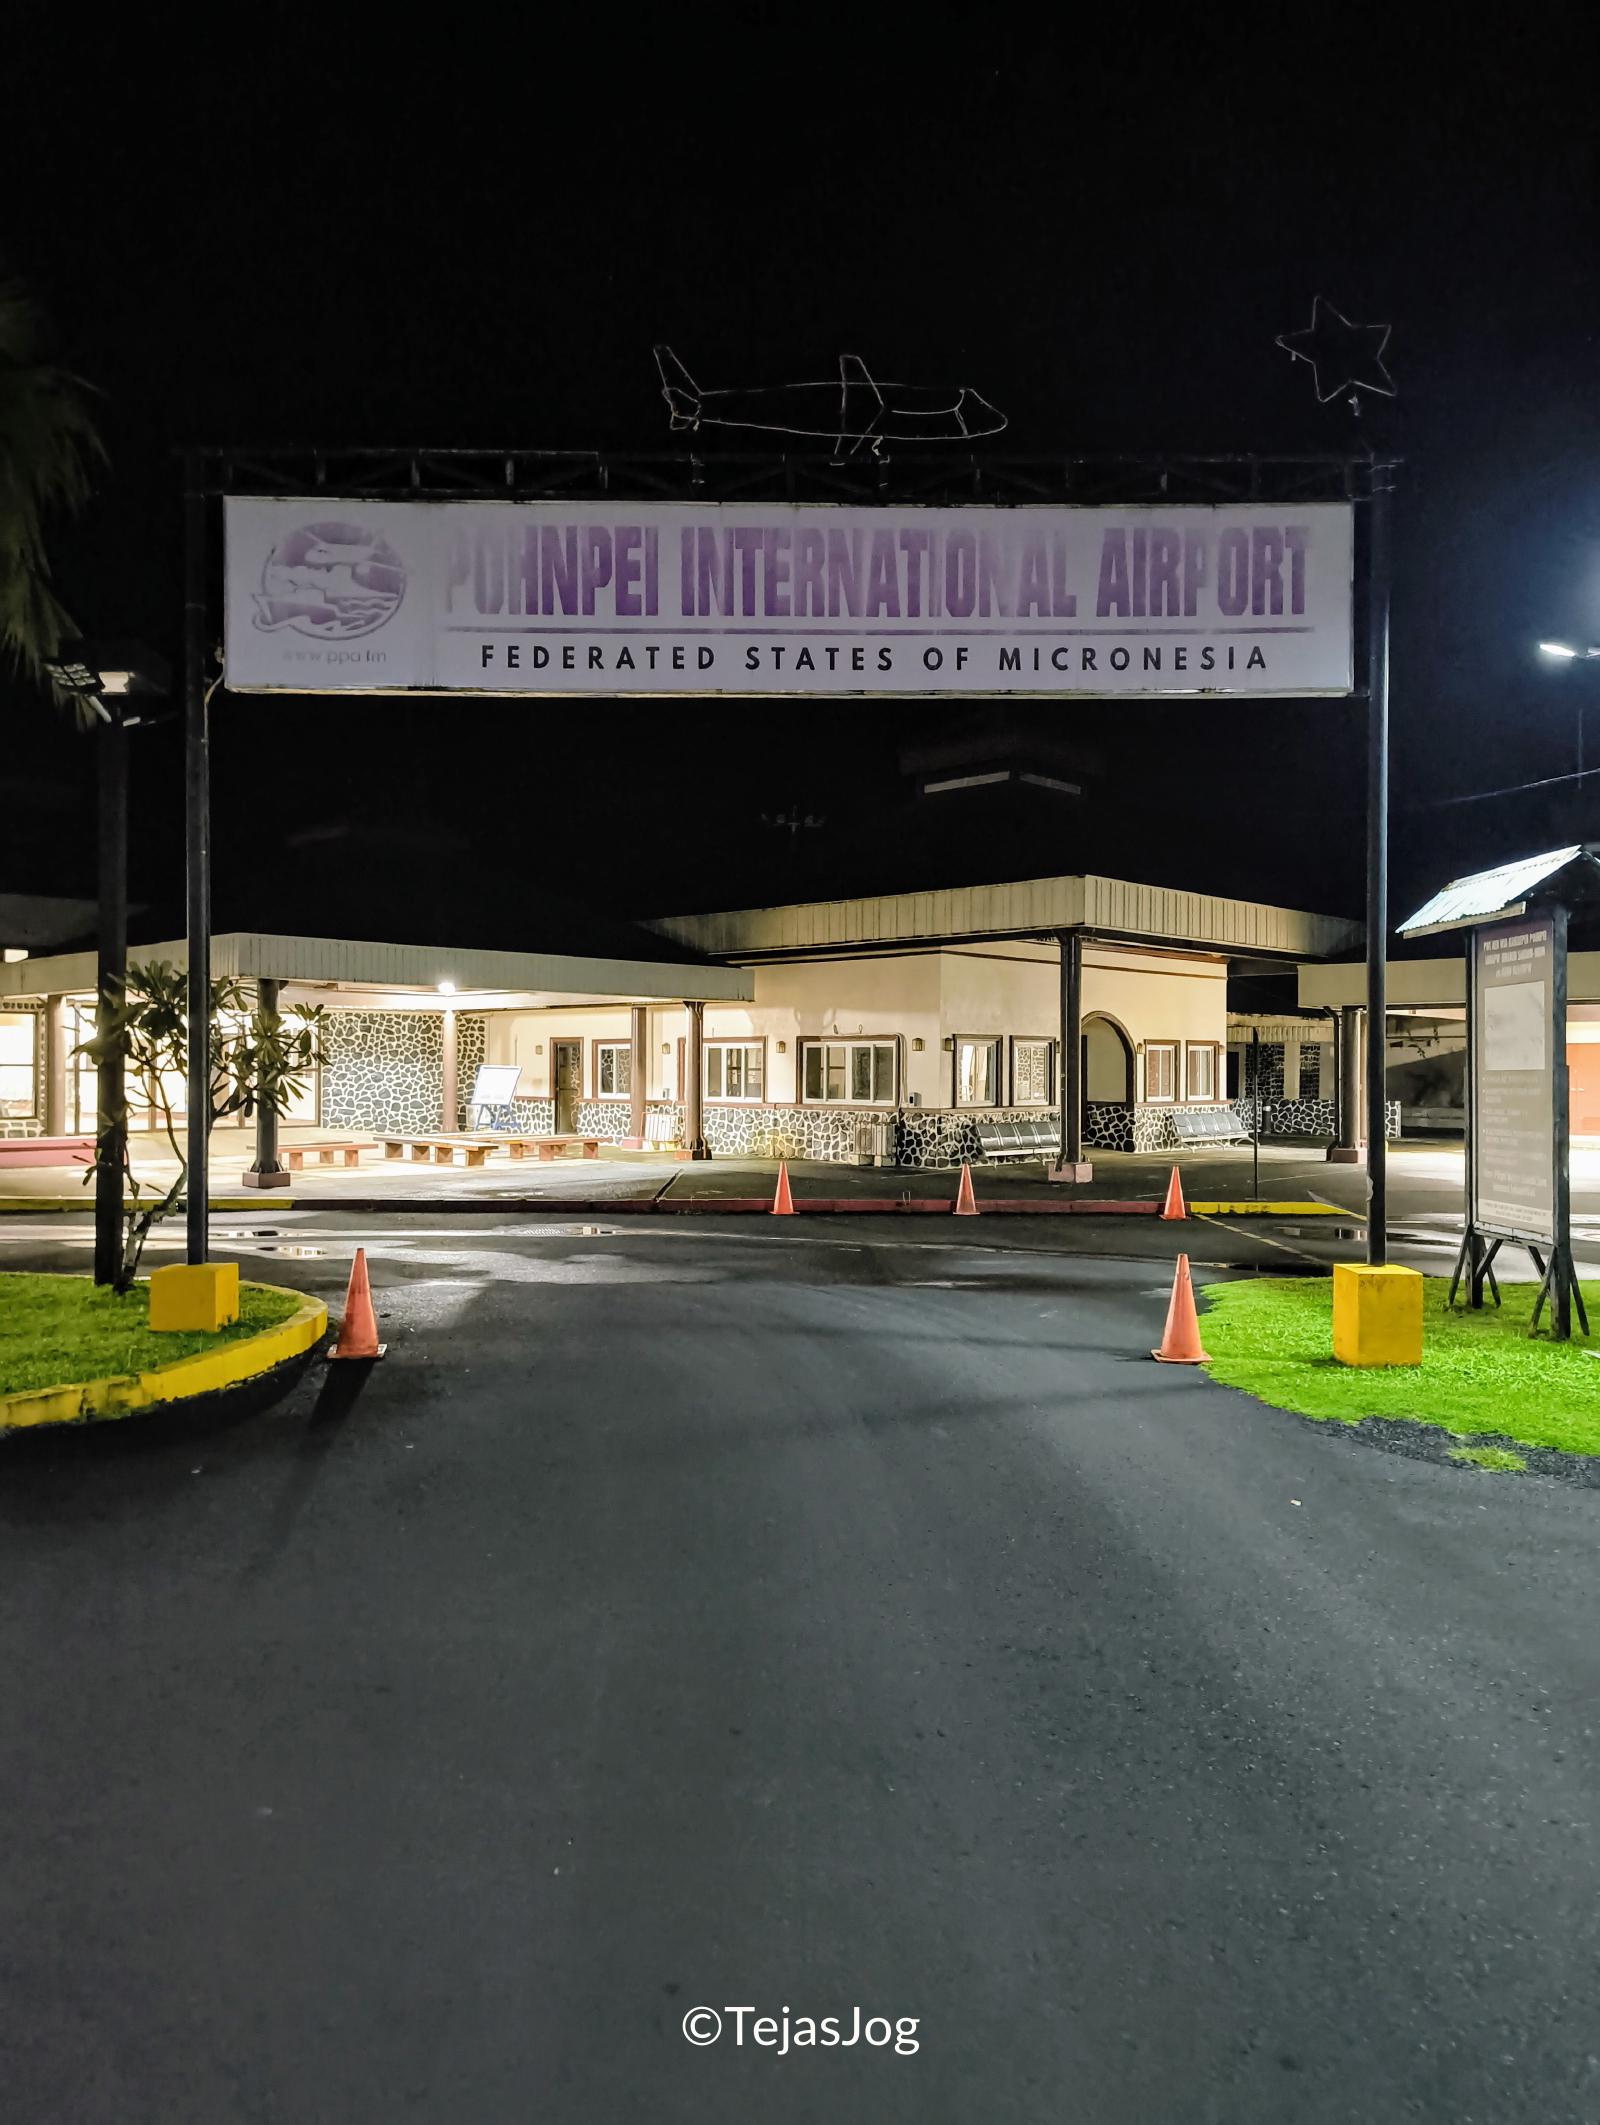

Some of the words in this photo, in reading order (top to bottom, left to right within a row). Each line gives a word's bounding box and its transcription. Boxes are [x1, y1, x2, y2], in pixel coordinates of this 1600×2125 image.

[681, 526, 1077, 618] INTERNATIONAL
[1096, 526, 1311, 617] AIRPORT
[481, 645, 715, 670] FEDERATED
[745, 646, 893, 671] STATES
[923, 647, 969, 671] OF
[999, 646, 1266, 671] MICRONESIA
